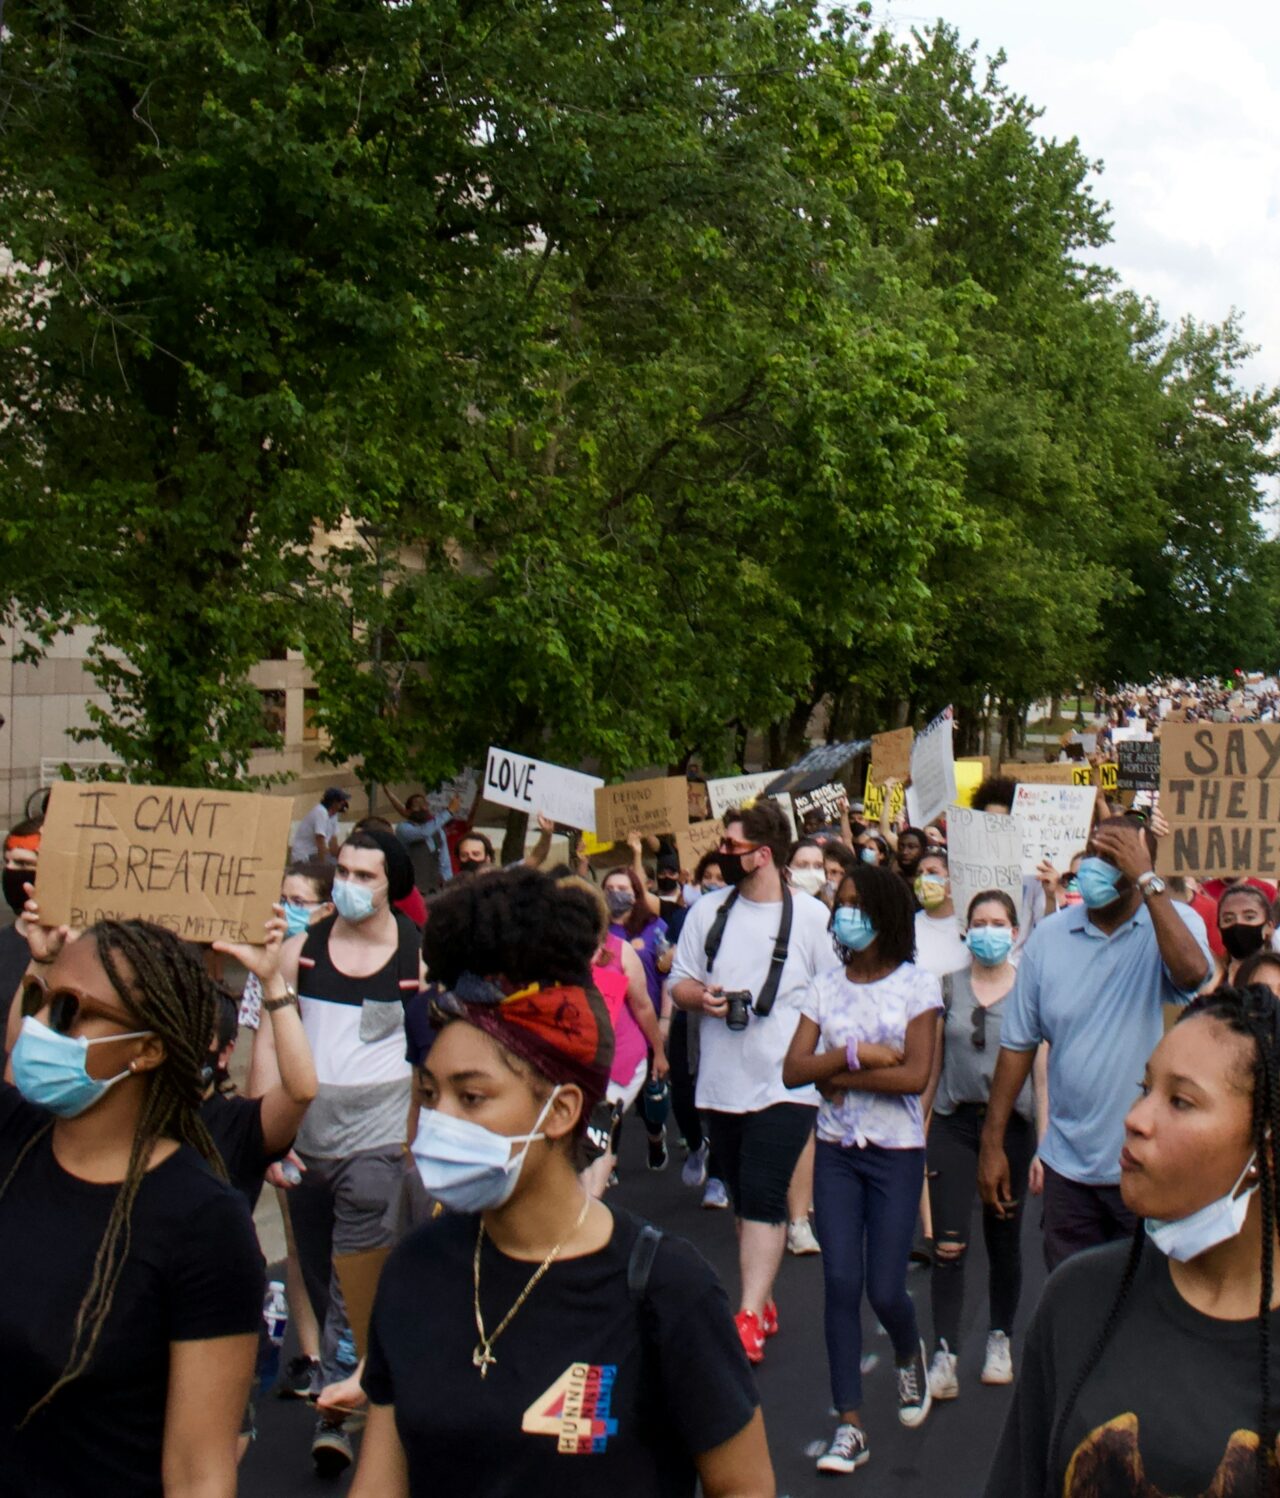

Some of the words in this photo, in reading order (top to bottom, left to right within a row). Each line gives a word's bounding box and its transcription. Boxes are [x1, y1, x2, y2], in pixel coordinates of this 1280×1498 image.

[488, 756, 536, 802] LOVE
[868, 783, 903, 804] LIVS
[74, 791, 119, 832] I
[134, 794, 231, 839] CANT
[948, 805, 973, 826] TO
[983, 812, 1017, 833] BE
[85, 842, 263, 896] BREATHE
[184, 913, 250, 942] MATTER
[560, 1366, 587, 1451] HUNNID
